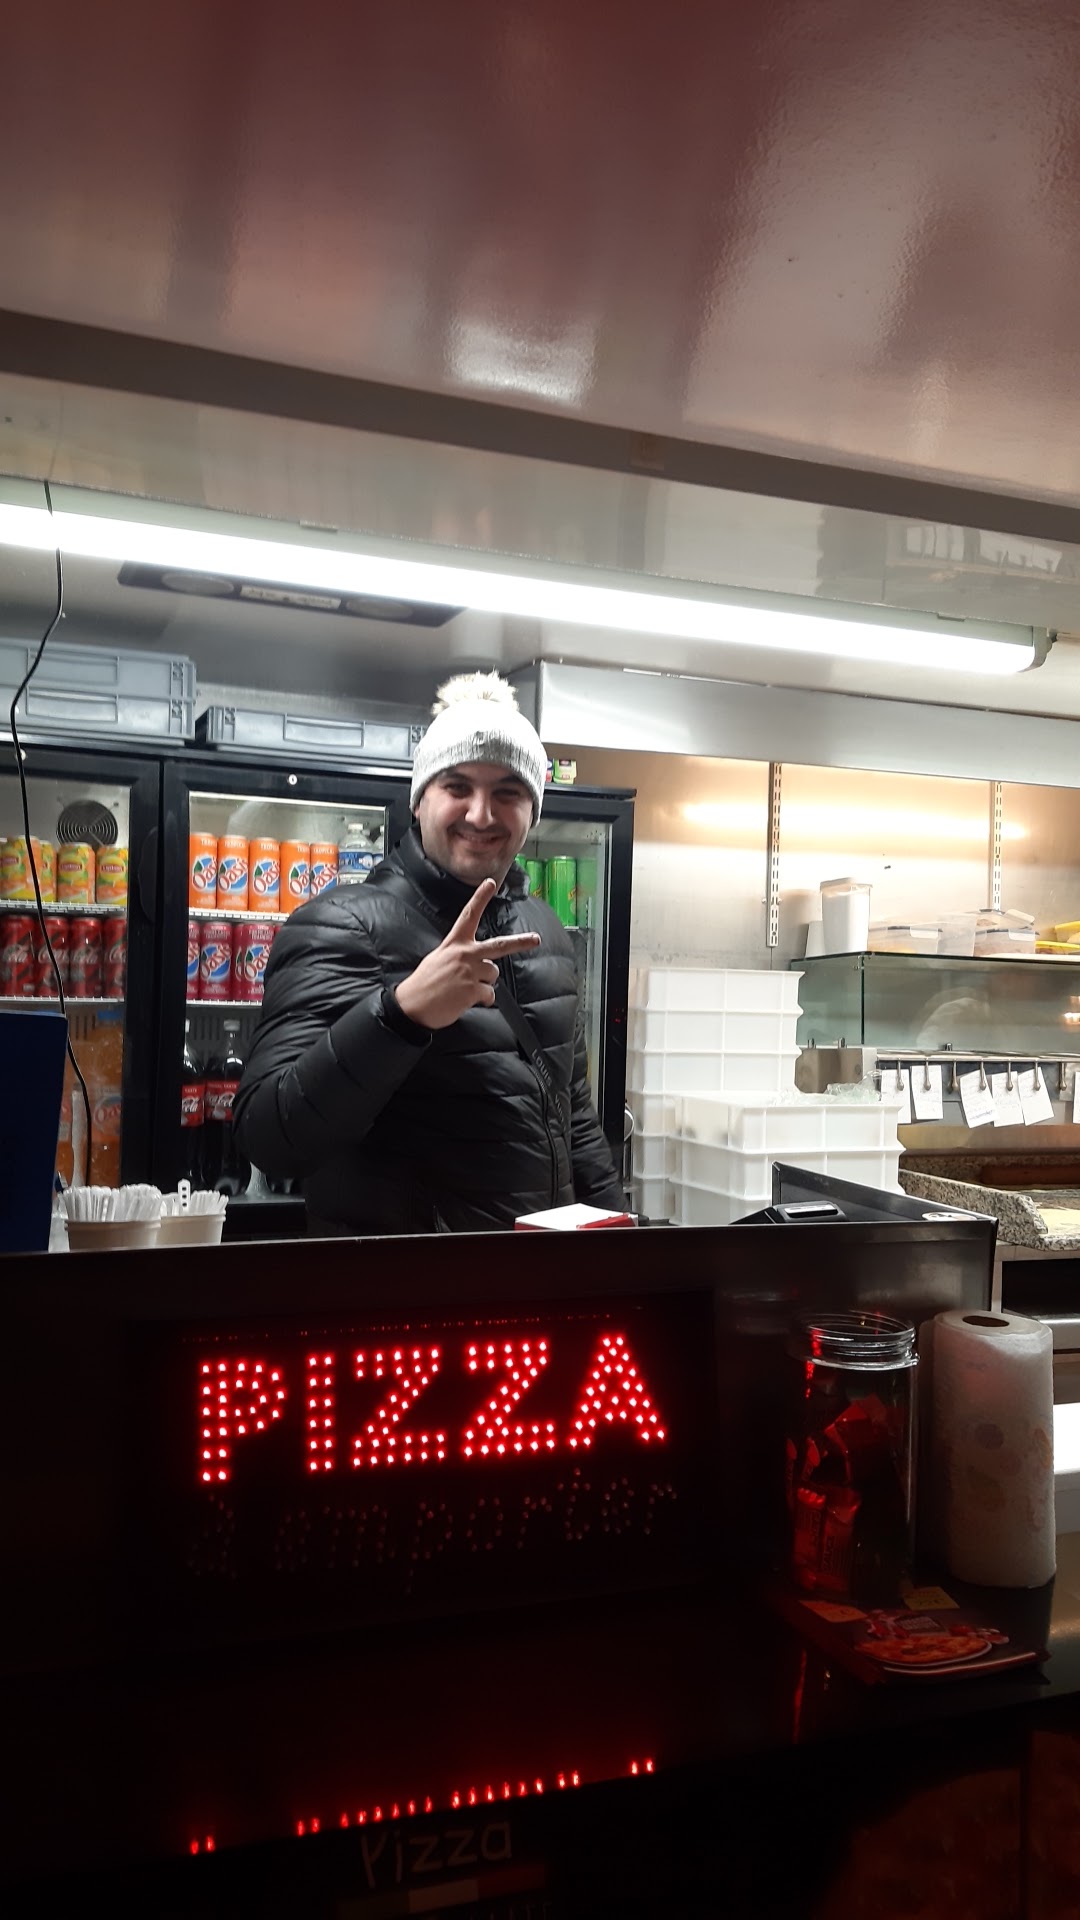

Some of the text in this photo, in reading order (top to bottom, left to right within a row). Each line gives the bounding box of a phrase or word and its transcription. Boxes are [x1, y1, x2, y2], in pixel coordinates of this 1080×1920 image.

[531, 1049, 552, 1087] LOUIS
[200, 1332, 667, 1483] PIZZA
[272, 1466, 680, 1595] emporter
